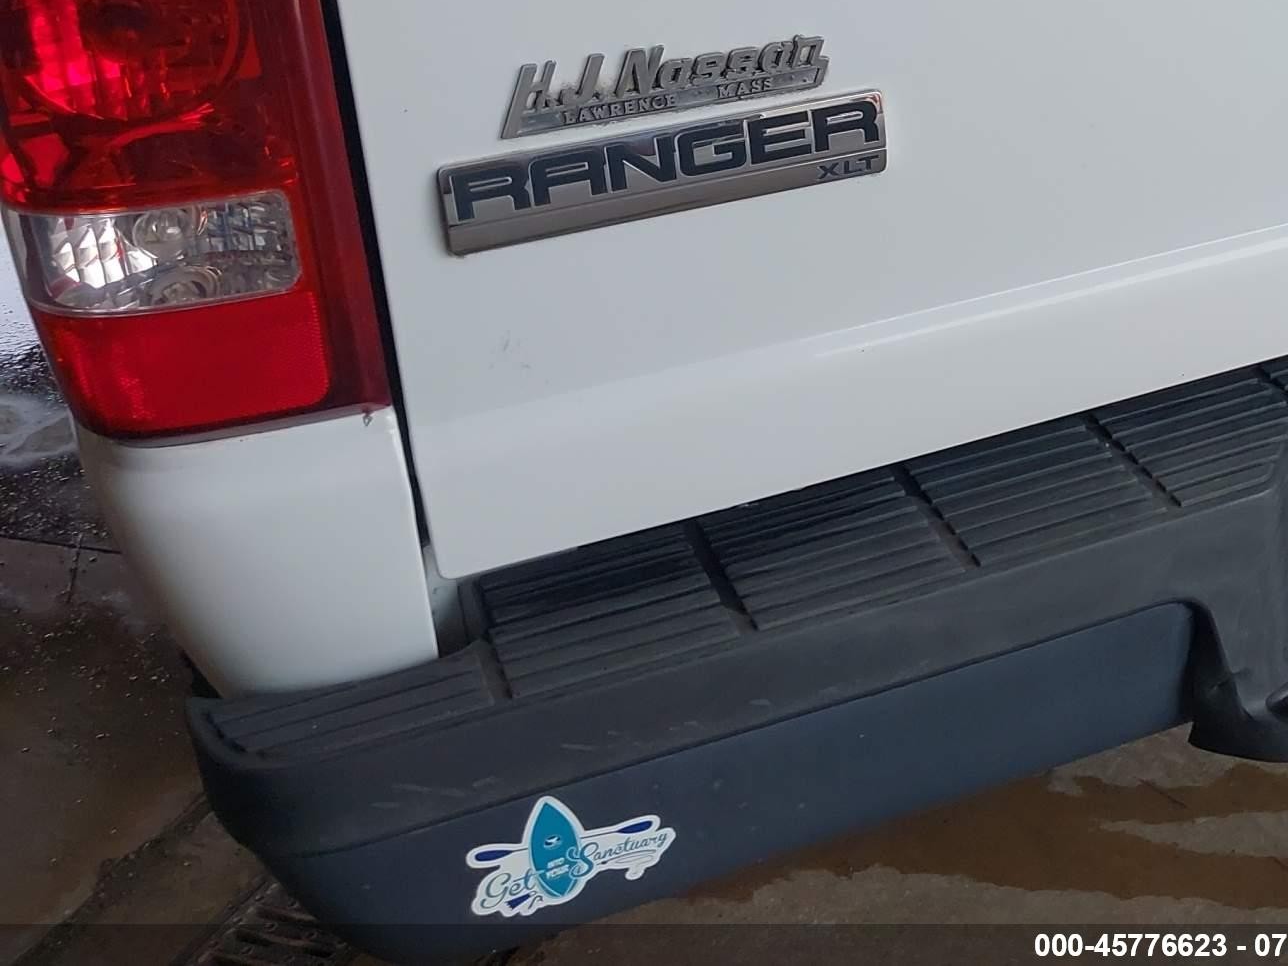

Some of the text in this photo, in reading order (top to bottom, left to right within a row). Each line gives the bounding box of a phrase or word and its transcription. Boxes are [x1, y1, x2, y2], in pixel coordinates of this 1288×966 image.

[562, 77, 773, 124] LAWRENCE MASS
[450, 100, 882, 222] RANGER
[817, 154, 879, 180] XLT
[565, 832, 668, 877] Sanctuary
[481, 868, 545, 909] Get
